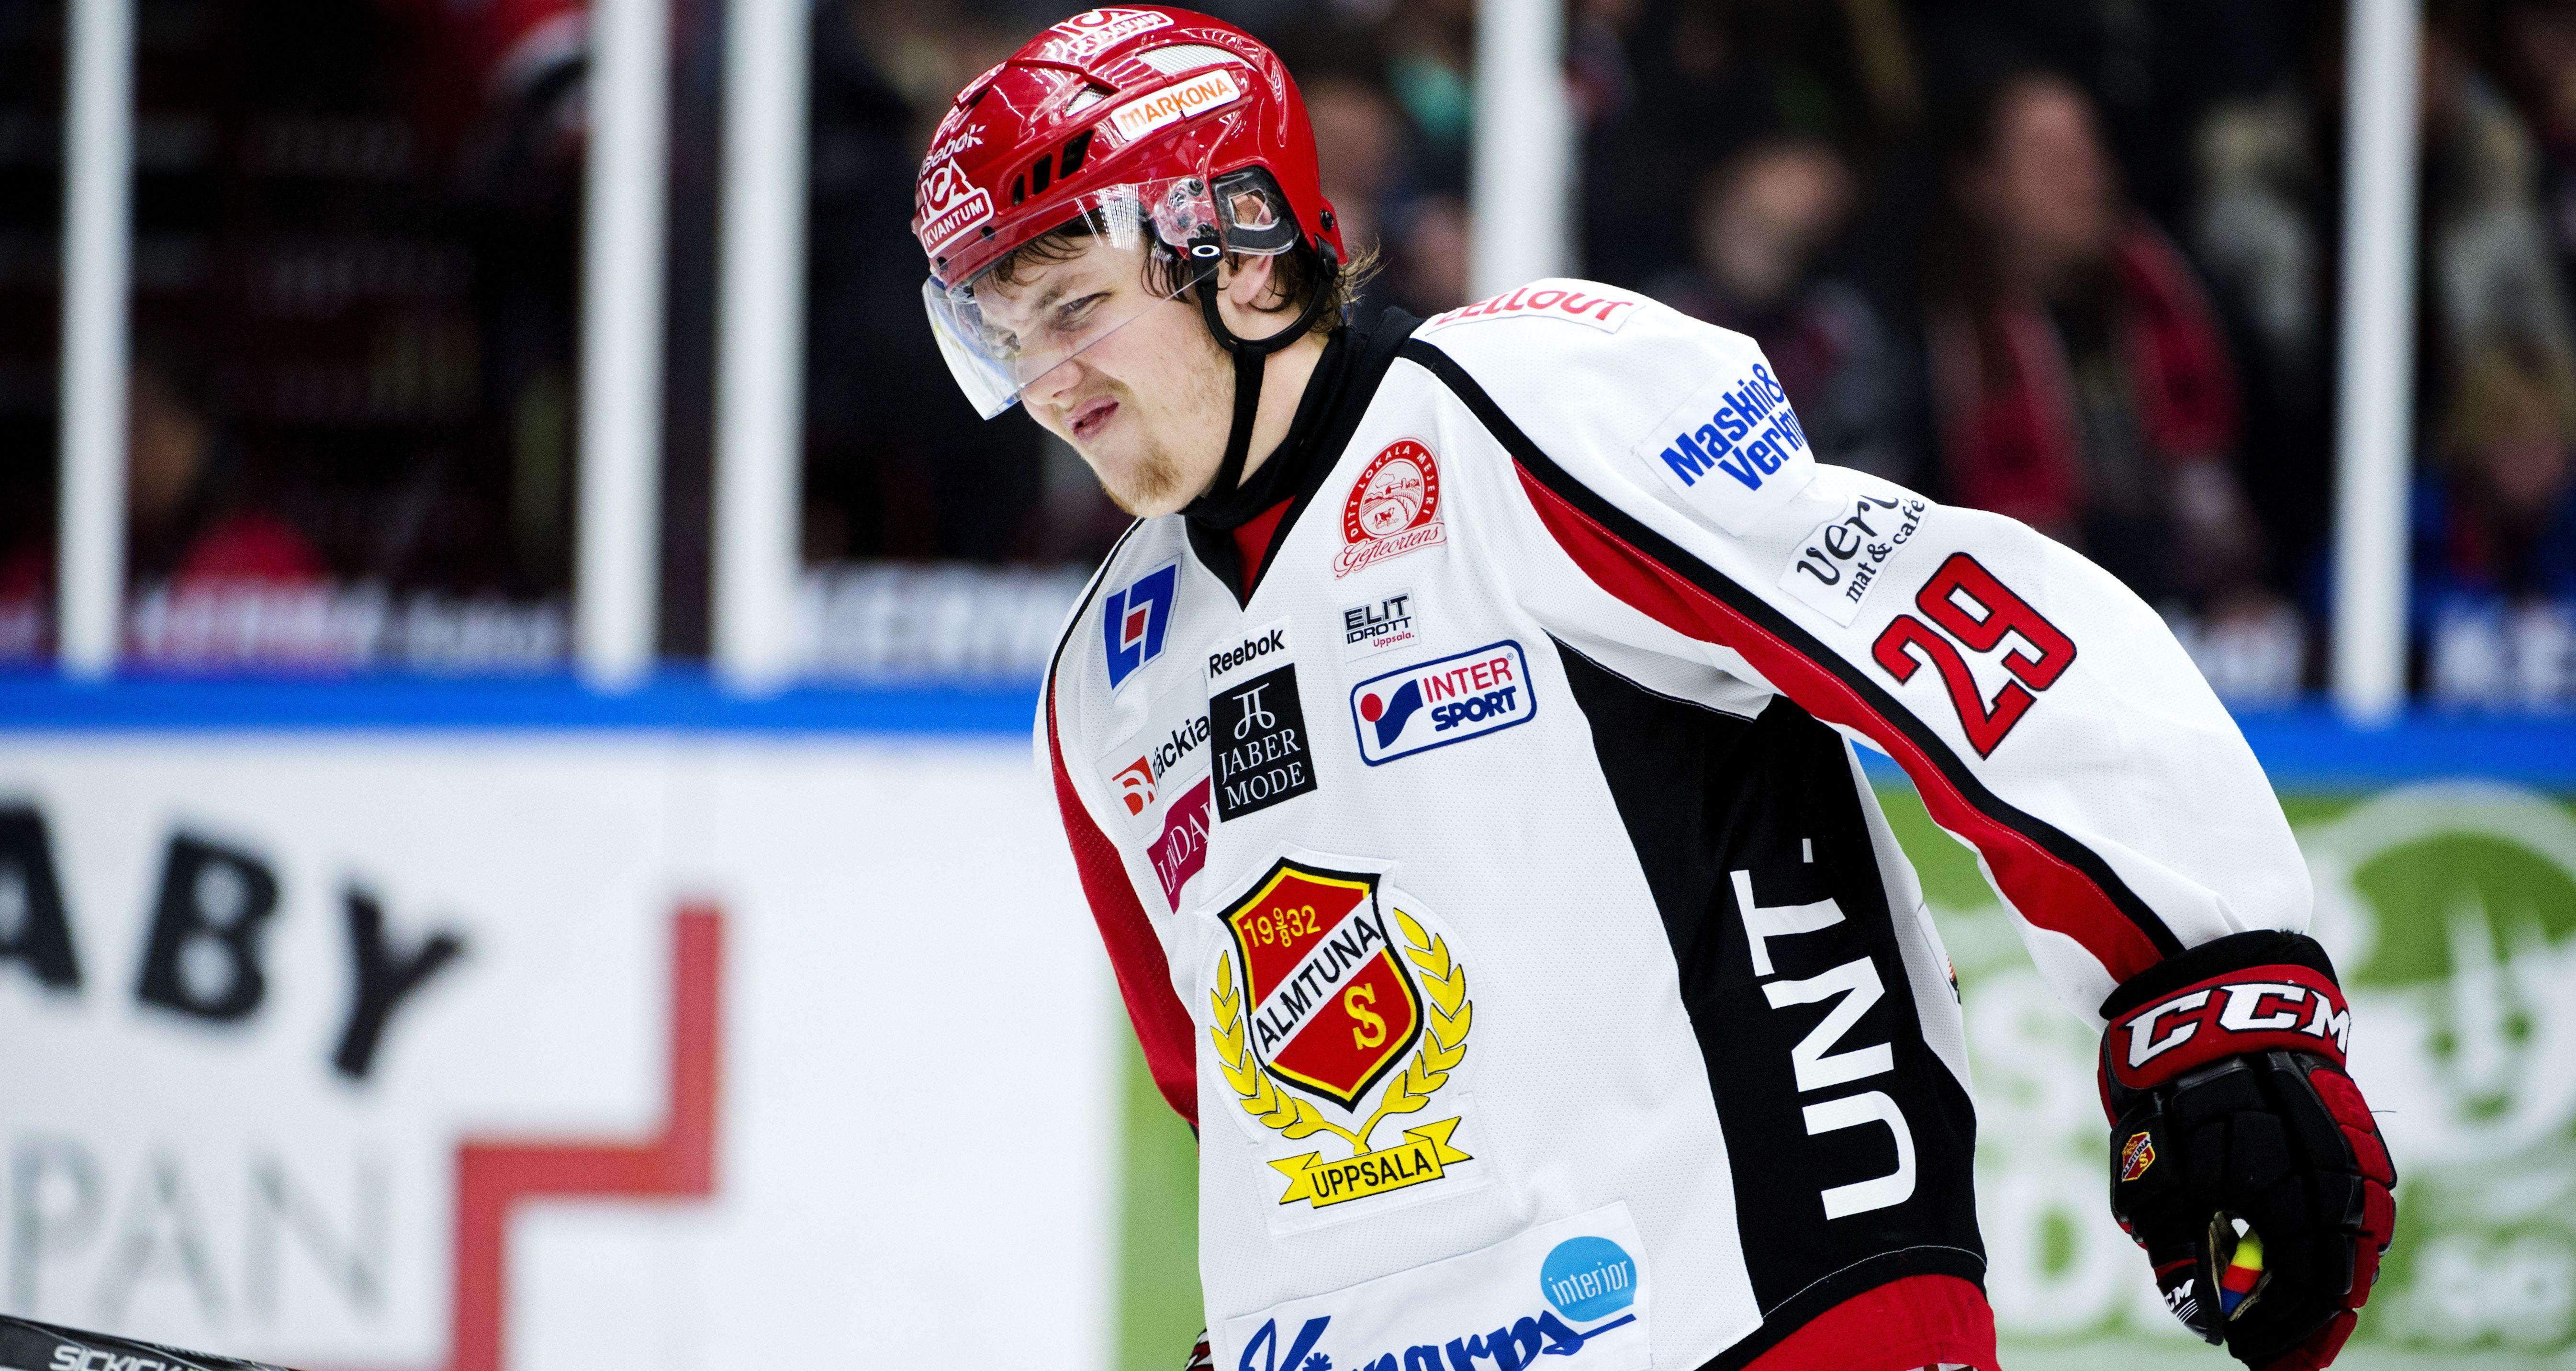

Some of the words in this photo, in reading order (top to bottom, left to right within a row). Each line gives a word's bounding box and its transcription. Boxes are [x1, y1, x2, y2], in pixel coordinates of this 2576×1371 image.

[921, 156, 976, 223] ICA
[924, 197, 985, 247] KVANTUM
[1347, 500, 1359, 538] DITT
[1358, 445, 1410, 489] LOKALA
[1417, 452, 1435, 515] MEJERI
[1336, 526, 1438, 578] Gefleortens
[1846, 562, 1877, 604] mat
[1867, 543, 1893, 563] &
[1893, 498, 1925, 544] café
[1343, 594, 1409, 631] ELIT
[1347, 617, 1411, 644] IDROTT
[1209, 629, 1285, 679] Reebok
[1373, 631, 1415, 648] Uppsala.
[1871, 551, 2077, 761] 29
[1423, 657, 1512, 703] INTER
[1431, 686, 1516, 732] SPORT
[1219, 728, 1301, 785] JABER
[1225, 761, 1305, 810] MODE
[1253, 915, 1381, 1054] ALMTUNA
[1344, 983, 1387, 1050] S
[2119, 982, 2350, 1068] CCM
[1311, 1147, 1434, 1199] UPPSALA
[1547, 1260, 1629, 1307] interior
